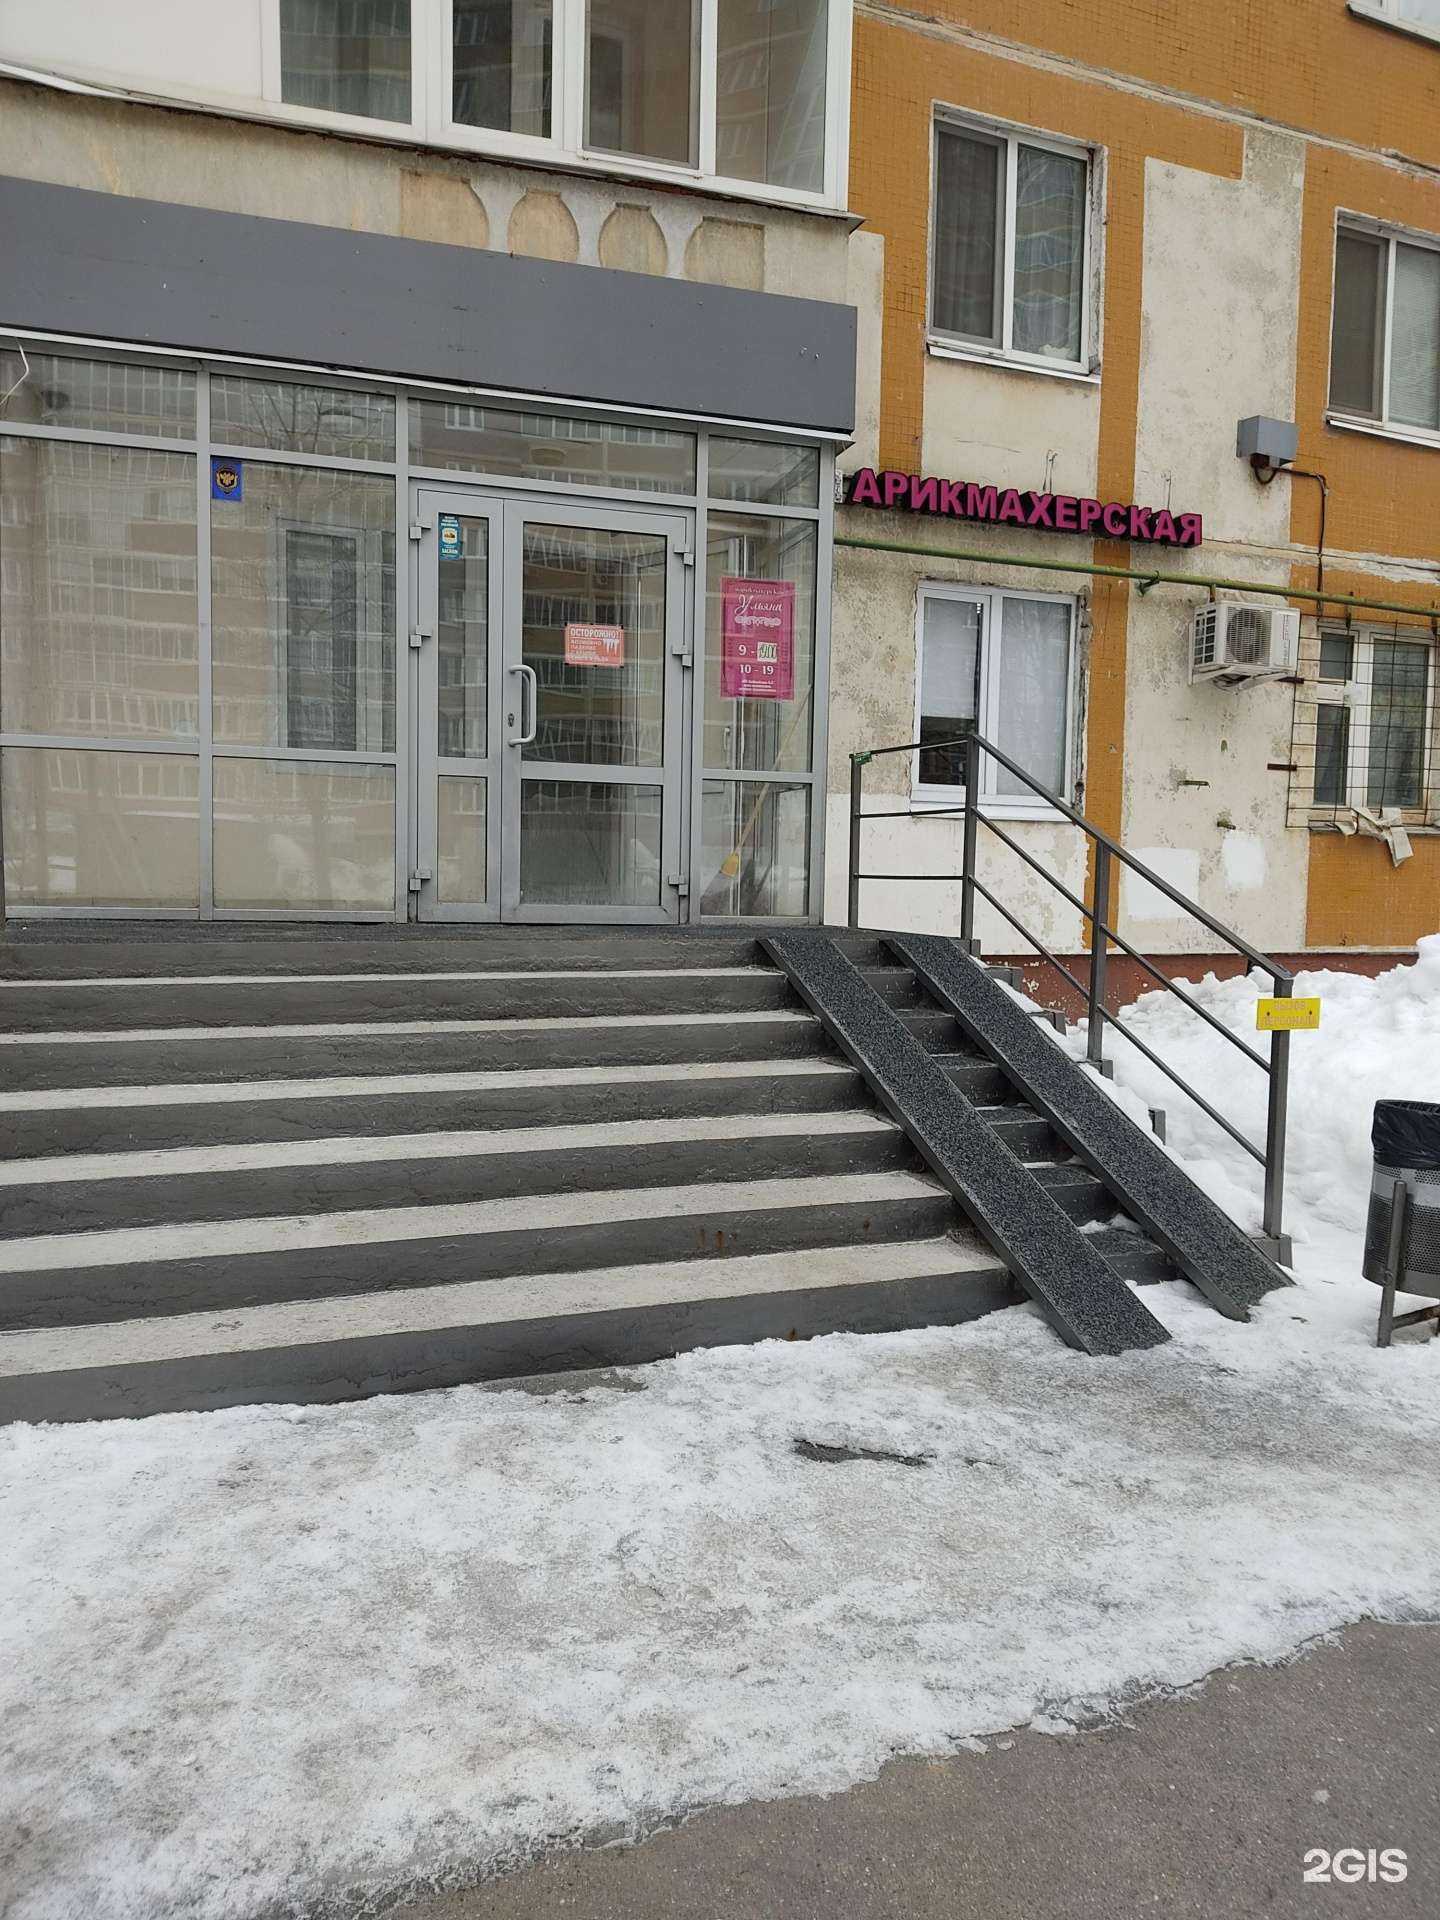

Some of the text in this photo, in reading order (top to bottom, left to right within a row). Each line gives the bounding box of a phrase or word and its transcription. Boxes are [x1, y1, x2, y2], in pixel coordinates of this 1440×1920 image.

[852, 467, 1203, 547] АРИКМАХЕРСКАЯ
[570, 628, 619, 638] ОСТОРОЖНО!
[738, 644, 747, 655] 9
[740, 664, 751, 673] 10
[762, 665, 774, 675] 19
